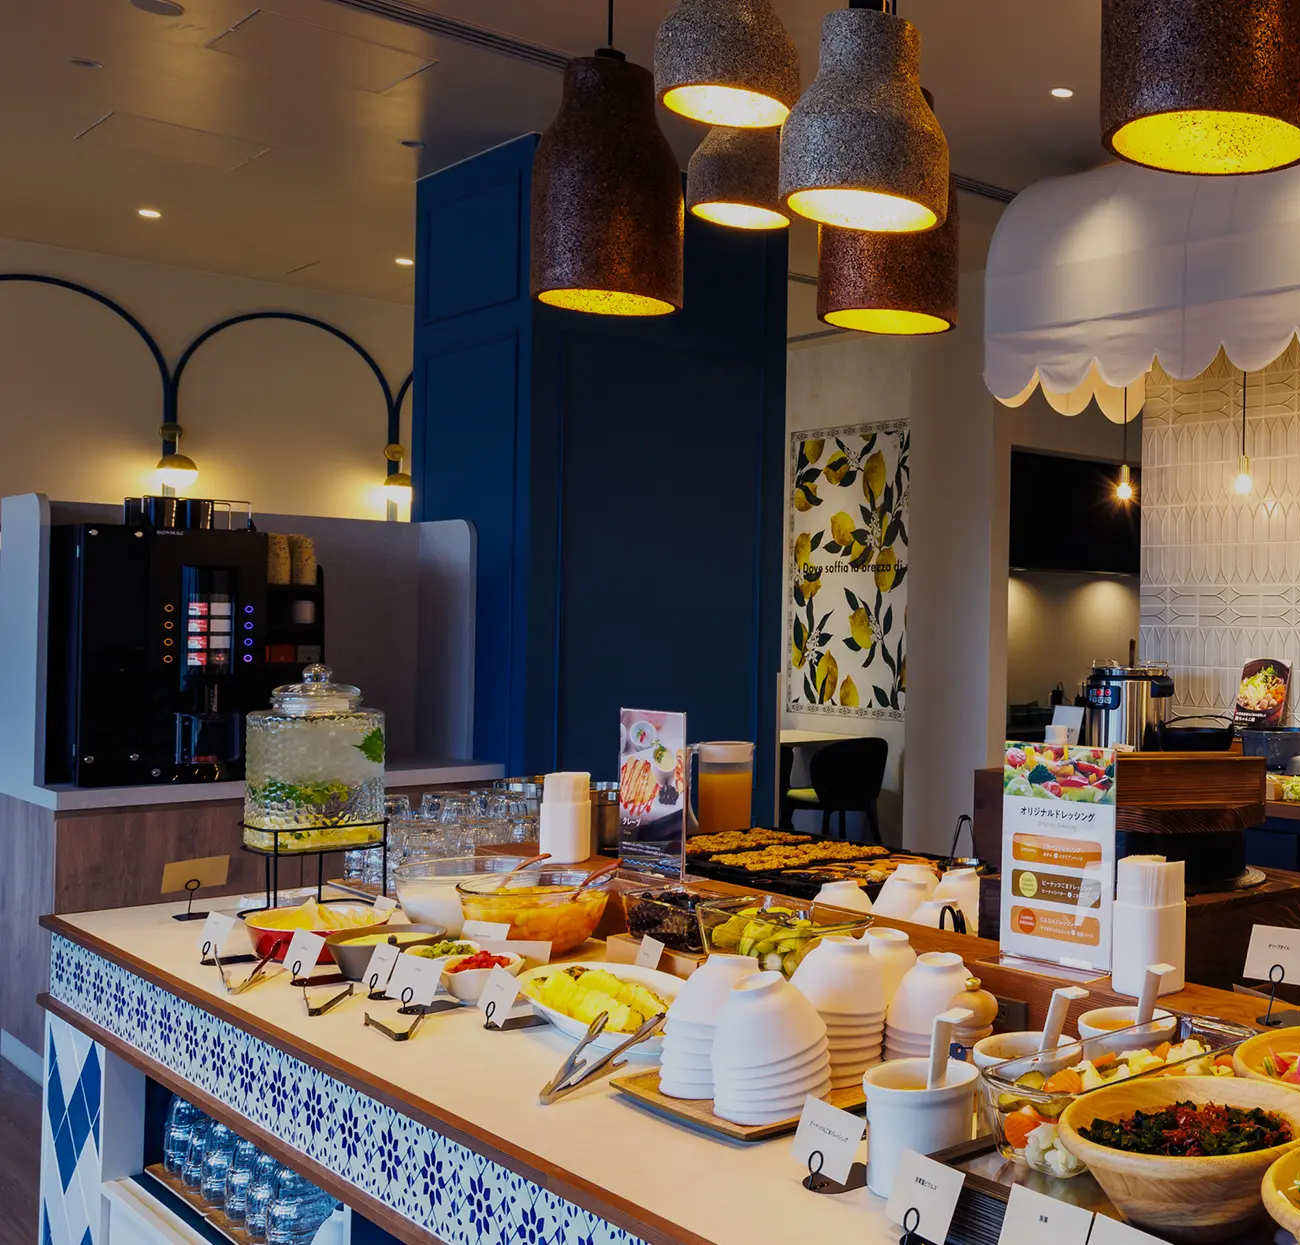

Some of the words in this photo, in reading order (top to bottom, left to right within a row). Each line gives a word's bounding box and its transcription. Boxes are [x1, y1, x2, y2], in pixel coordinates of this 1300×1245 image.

[803, 563, 822, 573] Dove
[825, 561, 849, 573] soffia
[862, 562, 891, 573] brezza
[894, 560, 903, 572] di
[1020, 806, 1096, 822] オリジナルドレッシング
[622, 816, 641, 827] クレープ
